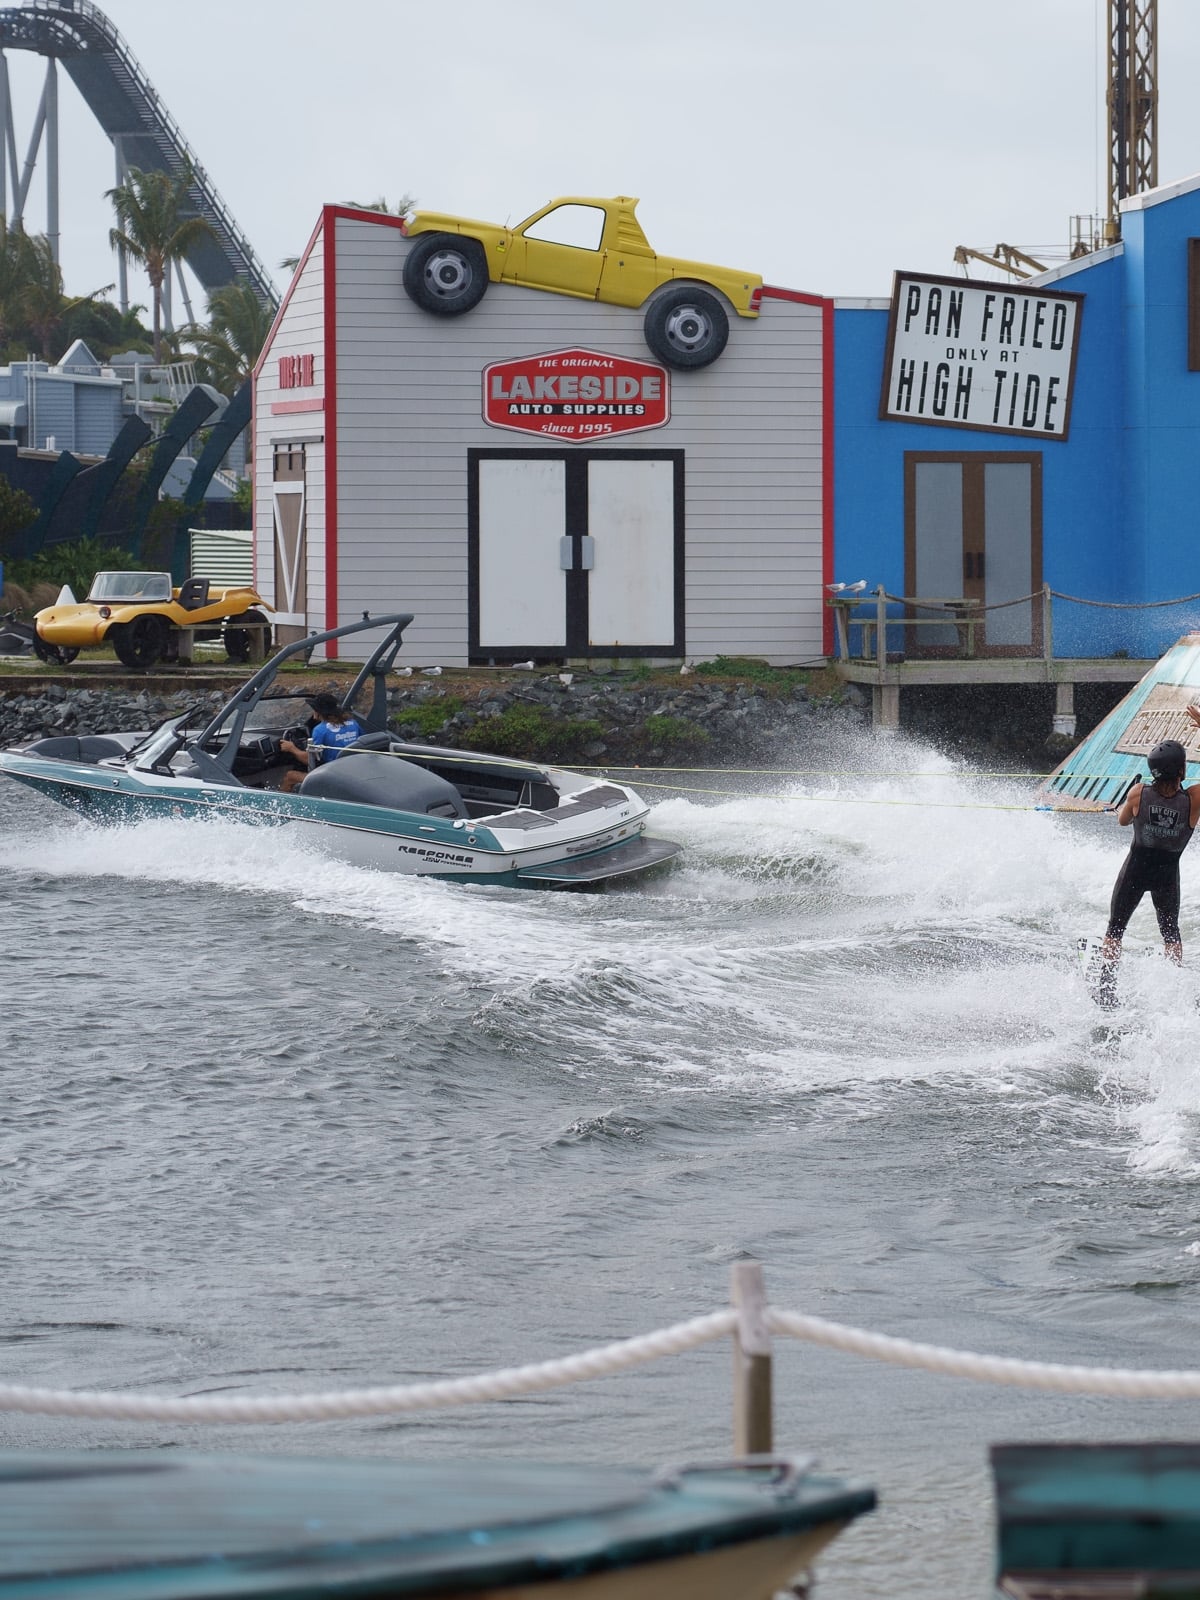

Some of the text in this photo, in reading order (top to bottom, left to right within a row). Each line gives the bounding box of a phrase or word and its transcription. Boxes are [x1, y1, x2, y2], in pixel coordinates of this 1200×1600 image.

[904, 285, 1067, 351] PAN FRIED
[538, 358, 615, 368] THE ORIGINAL
[945, 347, 1019, 362] ONLY AT
[491, 375, 661, 401] LAKESIDE
[896, 358, 1060, 431] HIGH TIDE
[509, 404, 645, 415] AUTO SUPPLIES
[540, 422, 613, 434] since 1995
[398, 845, 474, 864] RESPONSE
